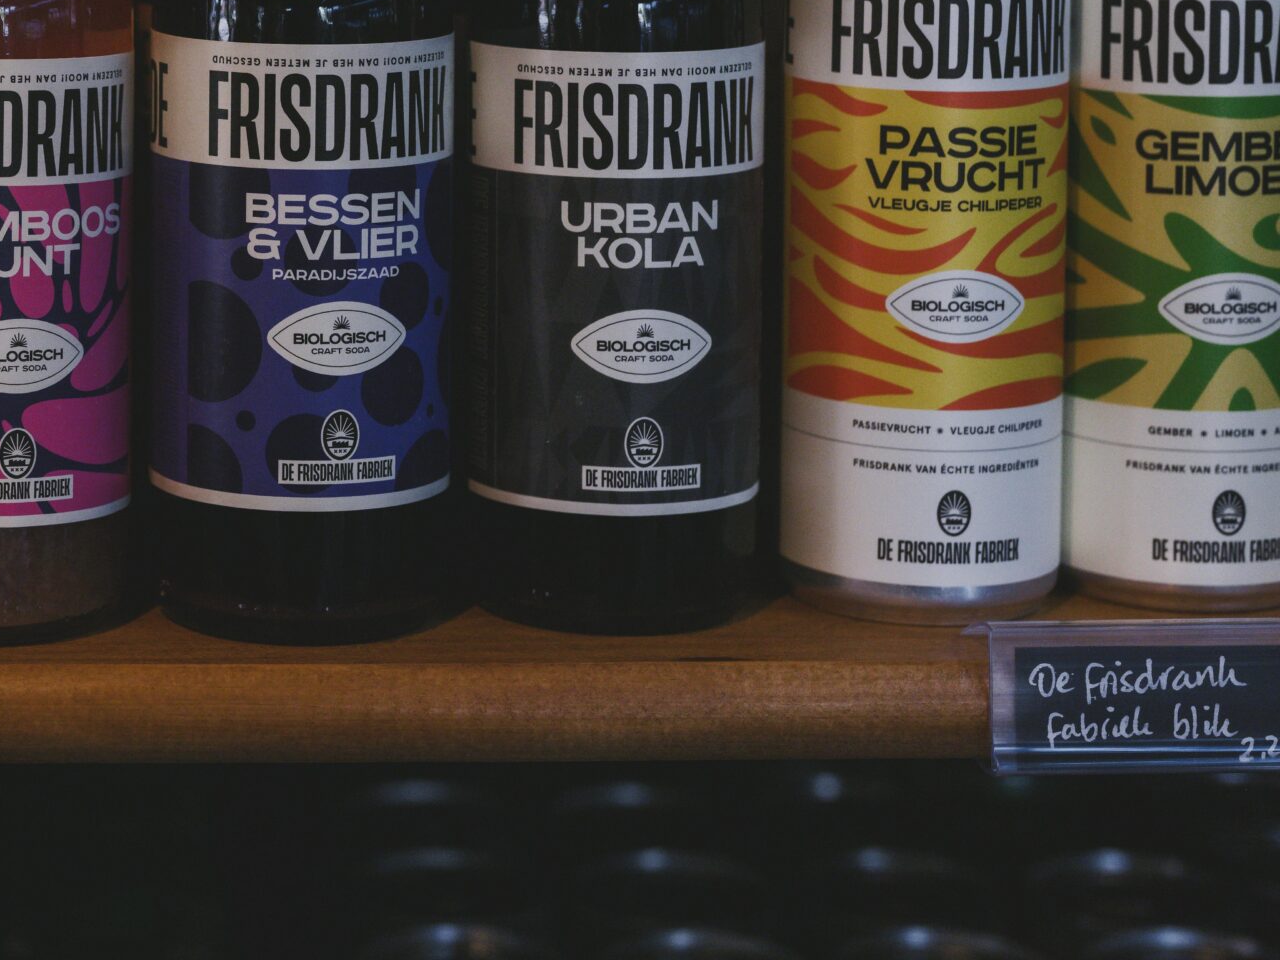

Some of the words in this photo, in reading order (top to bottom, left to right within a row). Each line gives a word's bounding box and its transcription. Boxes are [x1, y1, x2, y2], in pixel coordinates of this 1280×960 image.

[208, 65, 445, 162] FRISDRANK
[514, 76, 754, 171] FRISDRANK
[879, 124, 1037, 158] PASSIE
[865, 157, 1045, 193] VRUCHT
[245, 188, 420, 226] BESSEN
[868, 196, 952, 212] VLEUGJE
[957, 196, 1042, 212] CHILIPEPER
[561, 199, 718, 234] URBAN
[246, 227, 281, 261] &
[295, 224, 419, 261] VLIER
[577, 236, 705, 270] KOLA
[272, 266, 399, 281] PARADIJSZAAD
[911, 300, 1005, 313] BIOLOGISCH
[1184, 301, 1277, 315] BIOLOGISCH
[929, 315, 961, 323] CRAFT
[964, 315, 989, 323] SODA
[1202, 317, 1234, 325] CRAFT
[293, 331, 386, 345] BIOLOGISCH
[596, 339, 690, 352] BIOLOGISCH
[311, 347, 342, 355] CRAFT
[345, 346, 370, 355] SODA
[614, 355, 646, 363] CRAFT
[649, 354, 675, 362] SODA
[22, 364, 48, 372] SODA
[852, 419, 931, 435] PASSIEVRUCHT
[950, 425, 996, 435] VLEUGJE
[998, 419, 1042, 434] CHILIPEPER
[1148, 426, 1192, 437] GEMBER
[1215, 427, 1254, 438] LIMOEN
[281, 463, 294, 482] DE
[297, 461, 354, 482] FRISDRANK
[356, 459, 393, 479] FABRIEK
[853, 458, 912, 473] FRISDRANK
[915, 463, 936, 474] VAN
[940, 461, 975, 475] ÉCHTE
[978, 458, 1039, 474] INGREDIËNTEN
[1126, 460, 1186, 474] FRISDRANK
[1190, 464, 1211, 475] VAN
[1215, 462, 1249, 474] ÉCHTE
[585, 468, 599, 487] DE
[601, 469, 657, 489] FRISDRANK
[660, 467, 698, 487] FABRIEK
[33, 477, 71, 498] FABRIEK
[877, 537, 893, 562] DE
[897, 540, 971, 565] FRISDRANK
[975, 538, 1019, 564] FABRIEK
[1153, 538, 1168, 561] DE
[1173, 540, 1246, 563] FRISDRANK
[1028, 662, 1075, 698] De
